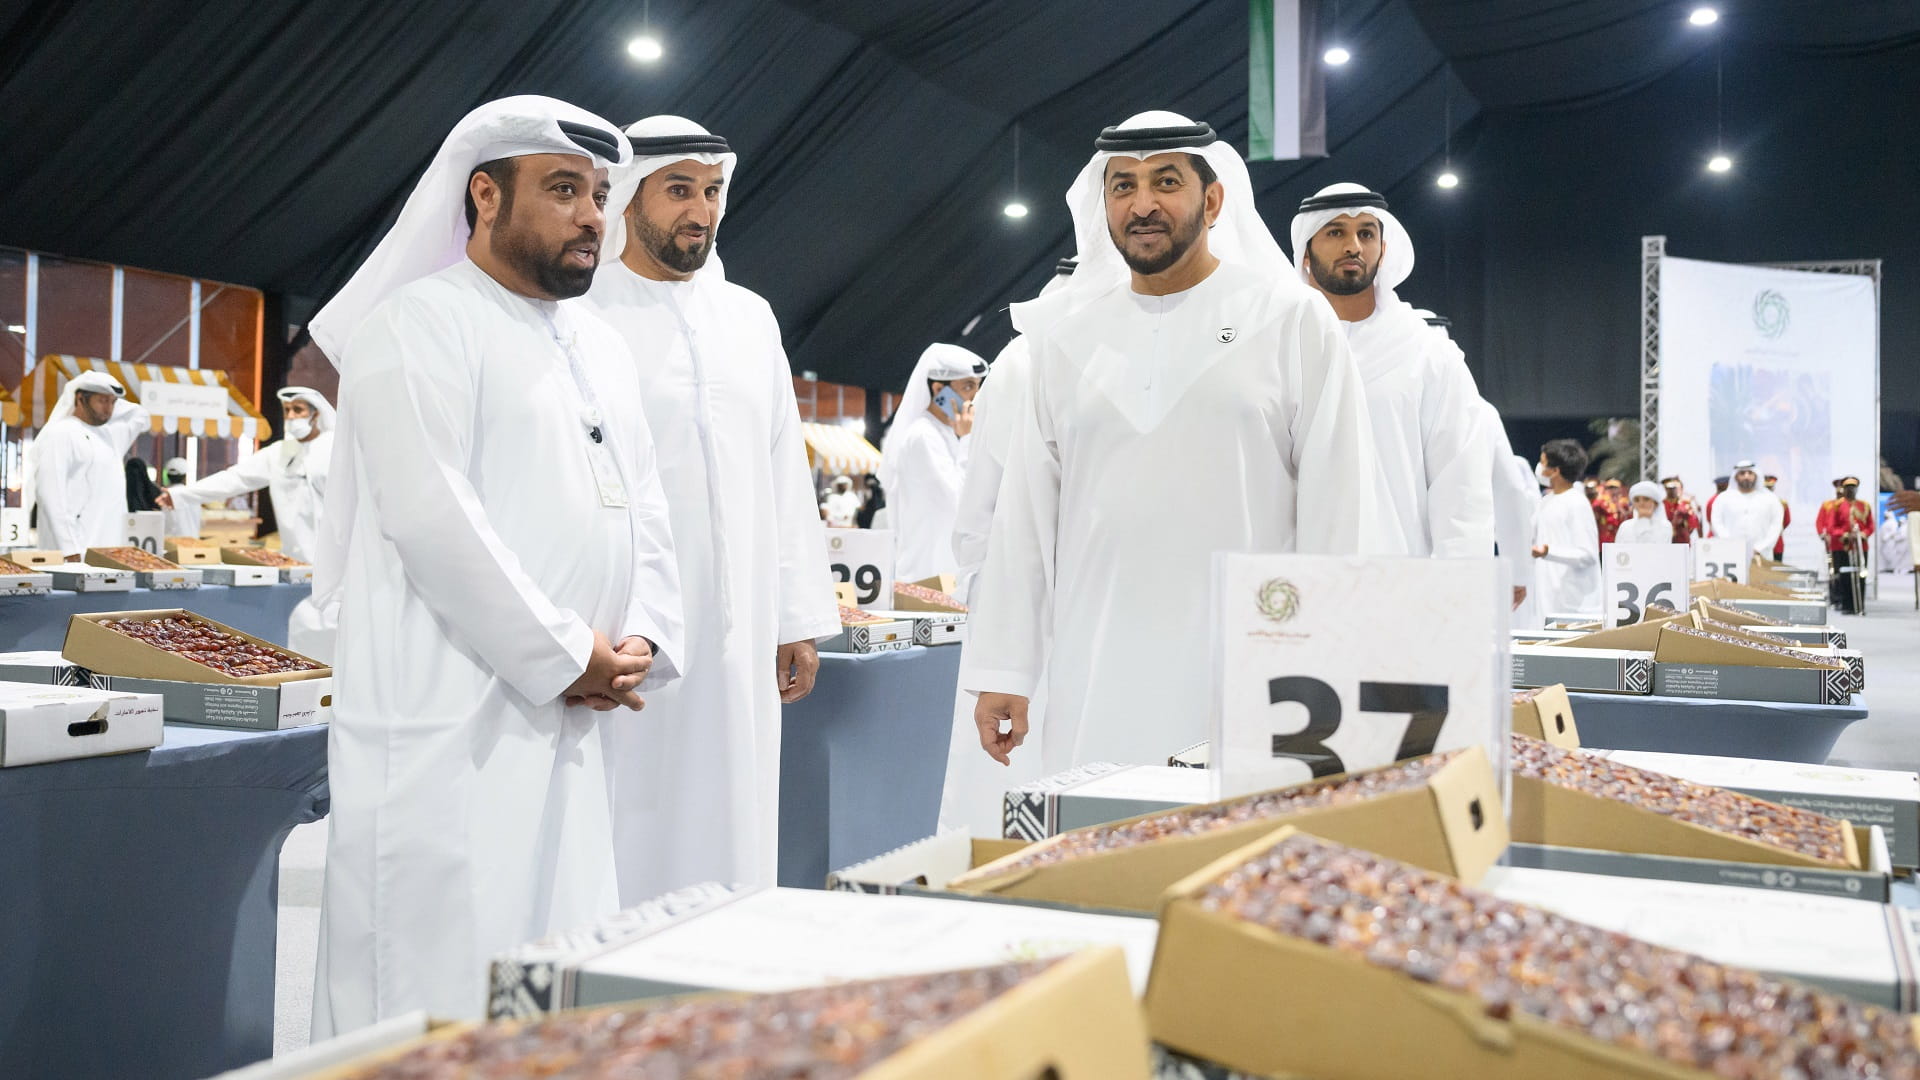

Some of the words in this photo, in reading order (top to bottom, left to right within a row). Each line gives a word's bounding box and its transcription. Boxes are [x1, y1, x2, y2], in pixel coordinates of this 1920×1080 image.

[1705, 562, 1738, 584] 35
[1616, 582, 1675, 627] 36
[1268, 675, 1449, 779] 37
